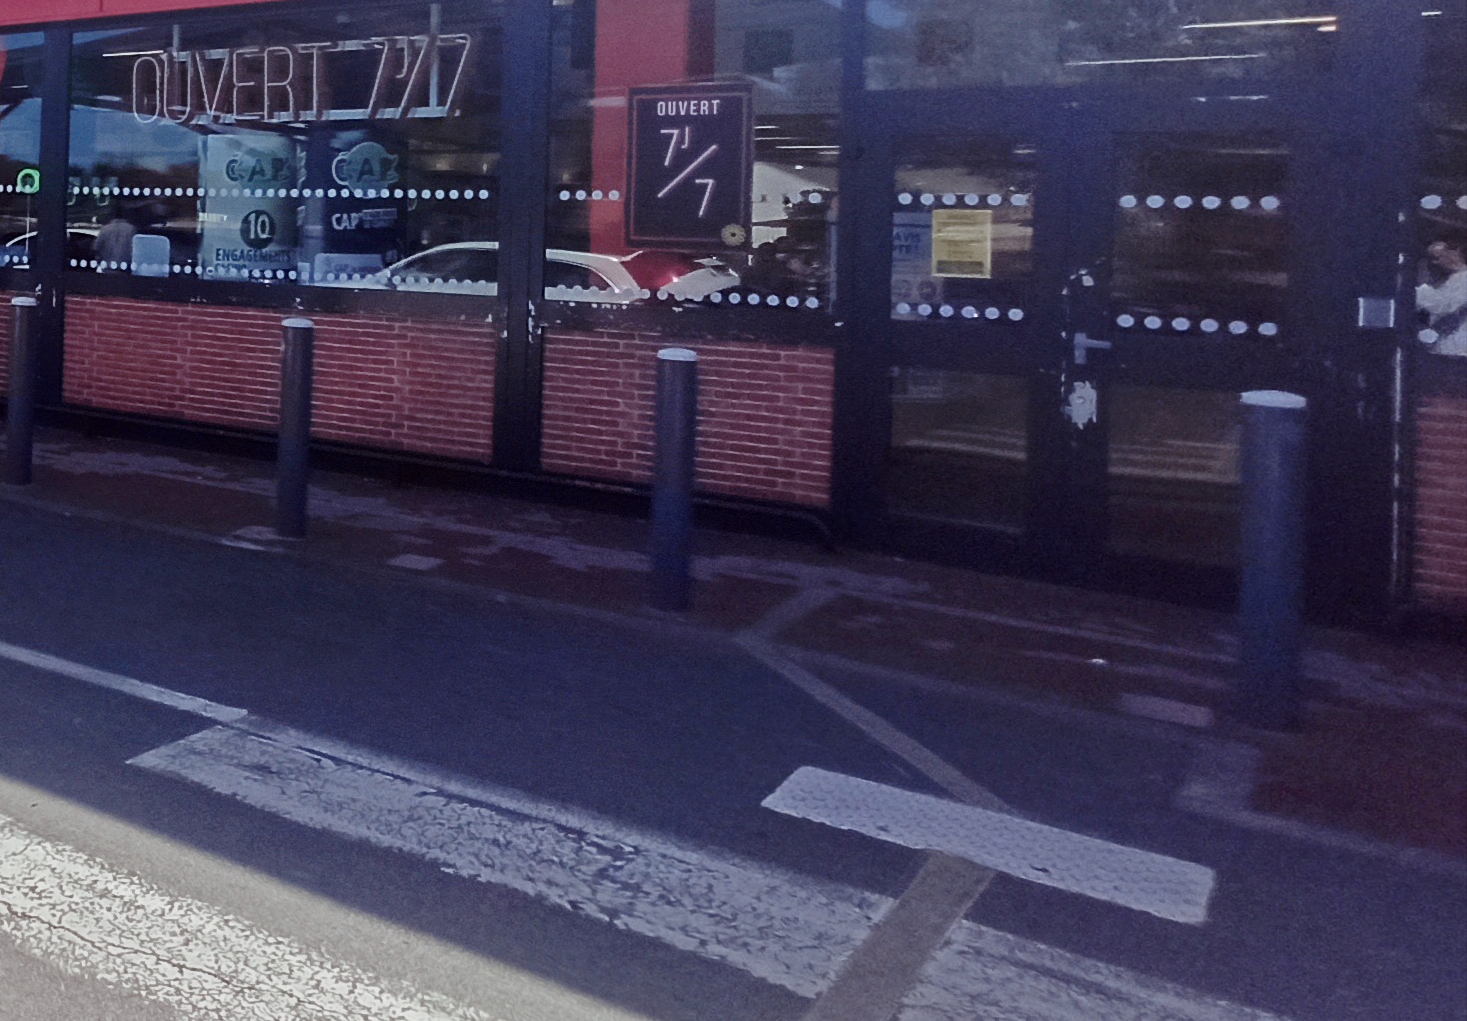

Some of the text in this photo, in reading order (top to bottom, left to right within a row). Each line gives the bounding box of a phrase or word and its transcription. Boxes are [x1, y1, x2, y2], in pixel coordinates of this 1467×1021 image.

[133, 42, 331, 123] OUVERT
[657, 99, 721, 116] OUVERT
[247, 212, 271, 239] 10
